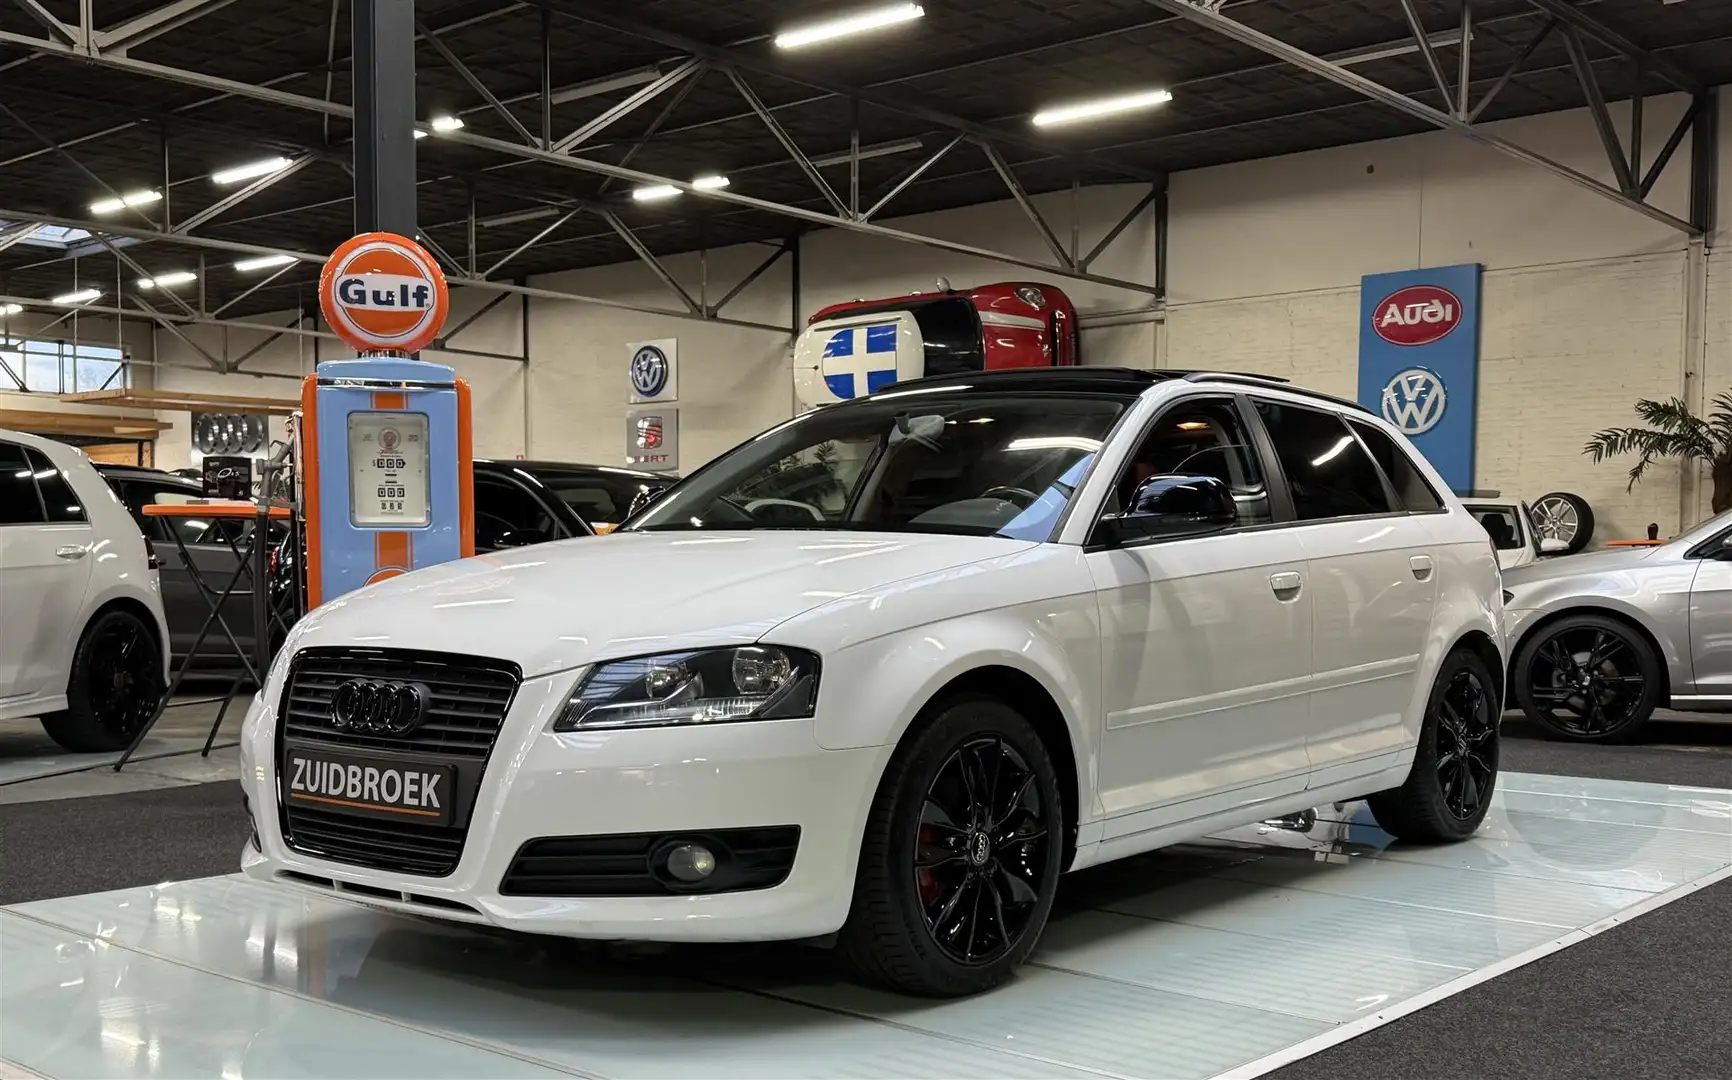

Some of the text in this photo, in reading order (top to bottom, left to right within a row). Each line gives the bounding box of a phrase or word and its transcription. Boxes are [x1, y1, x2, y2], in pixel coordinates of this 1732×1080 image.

[339, 279, 428, 308] Gulf
[1380, 299, 1452, 327] Audi
[291, 758, 441, 808] ZUIDBROEK
